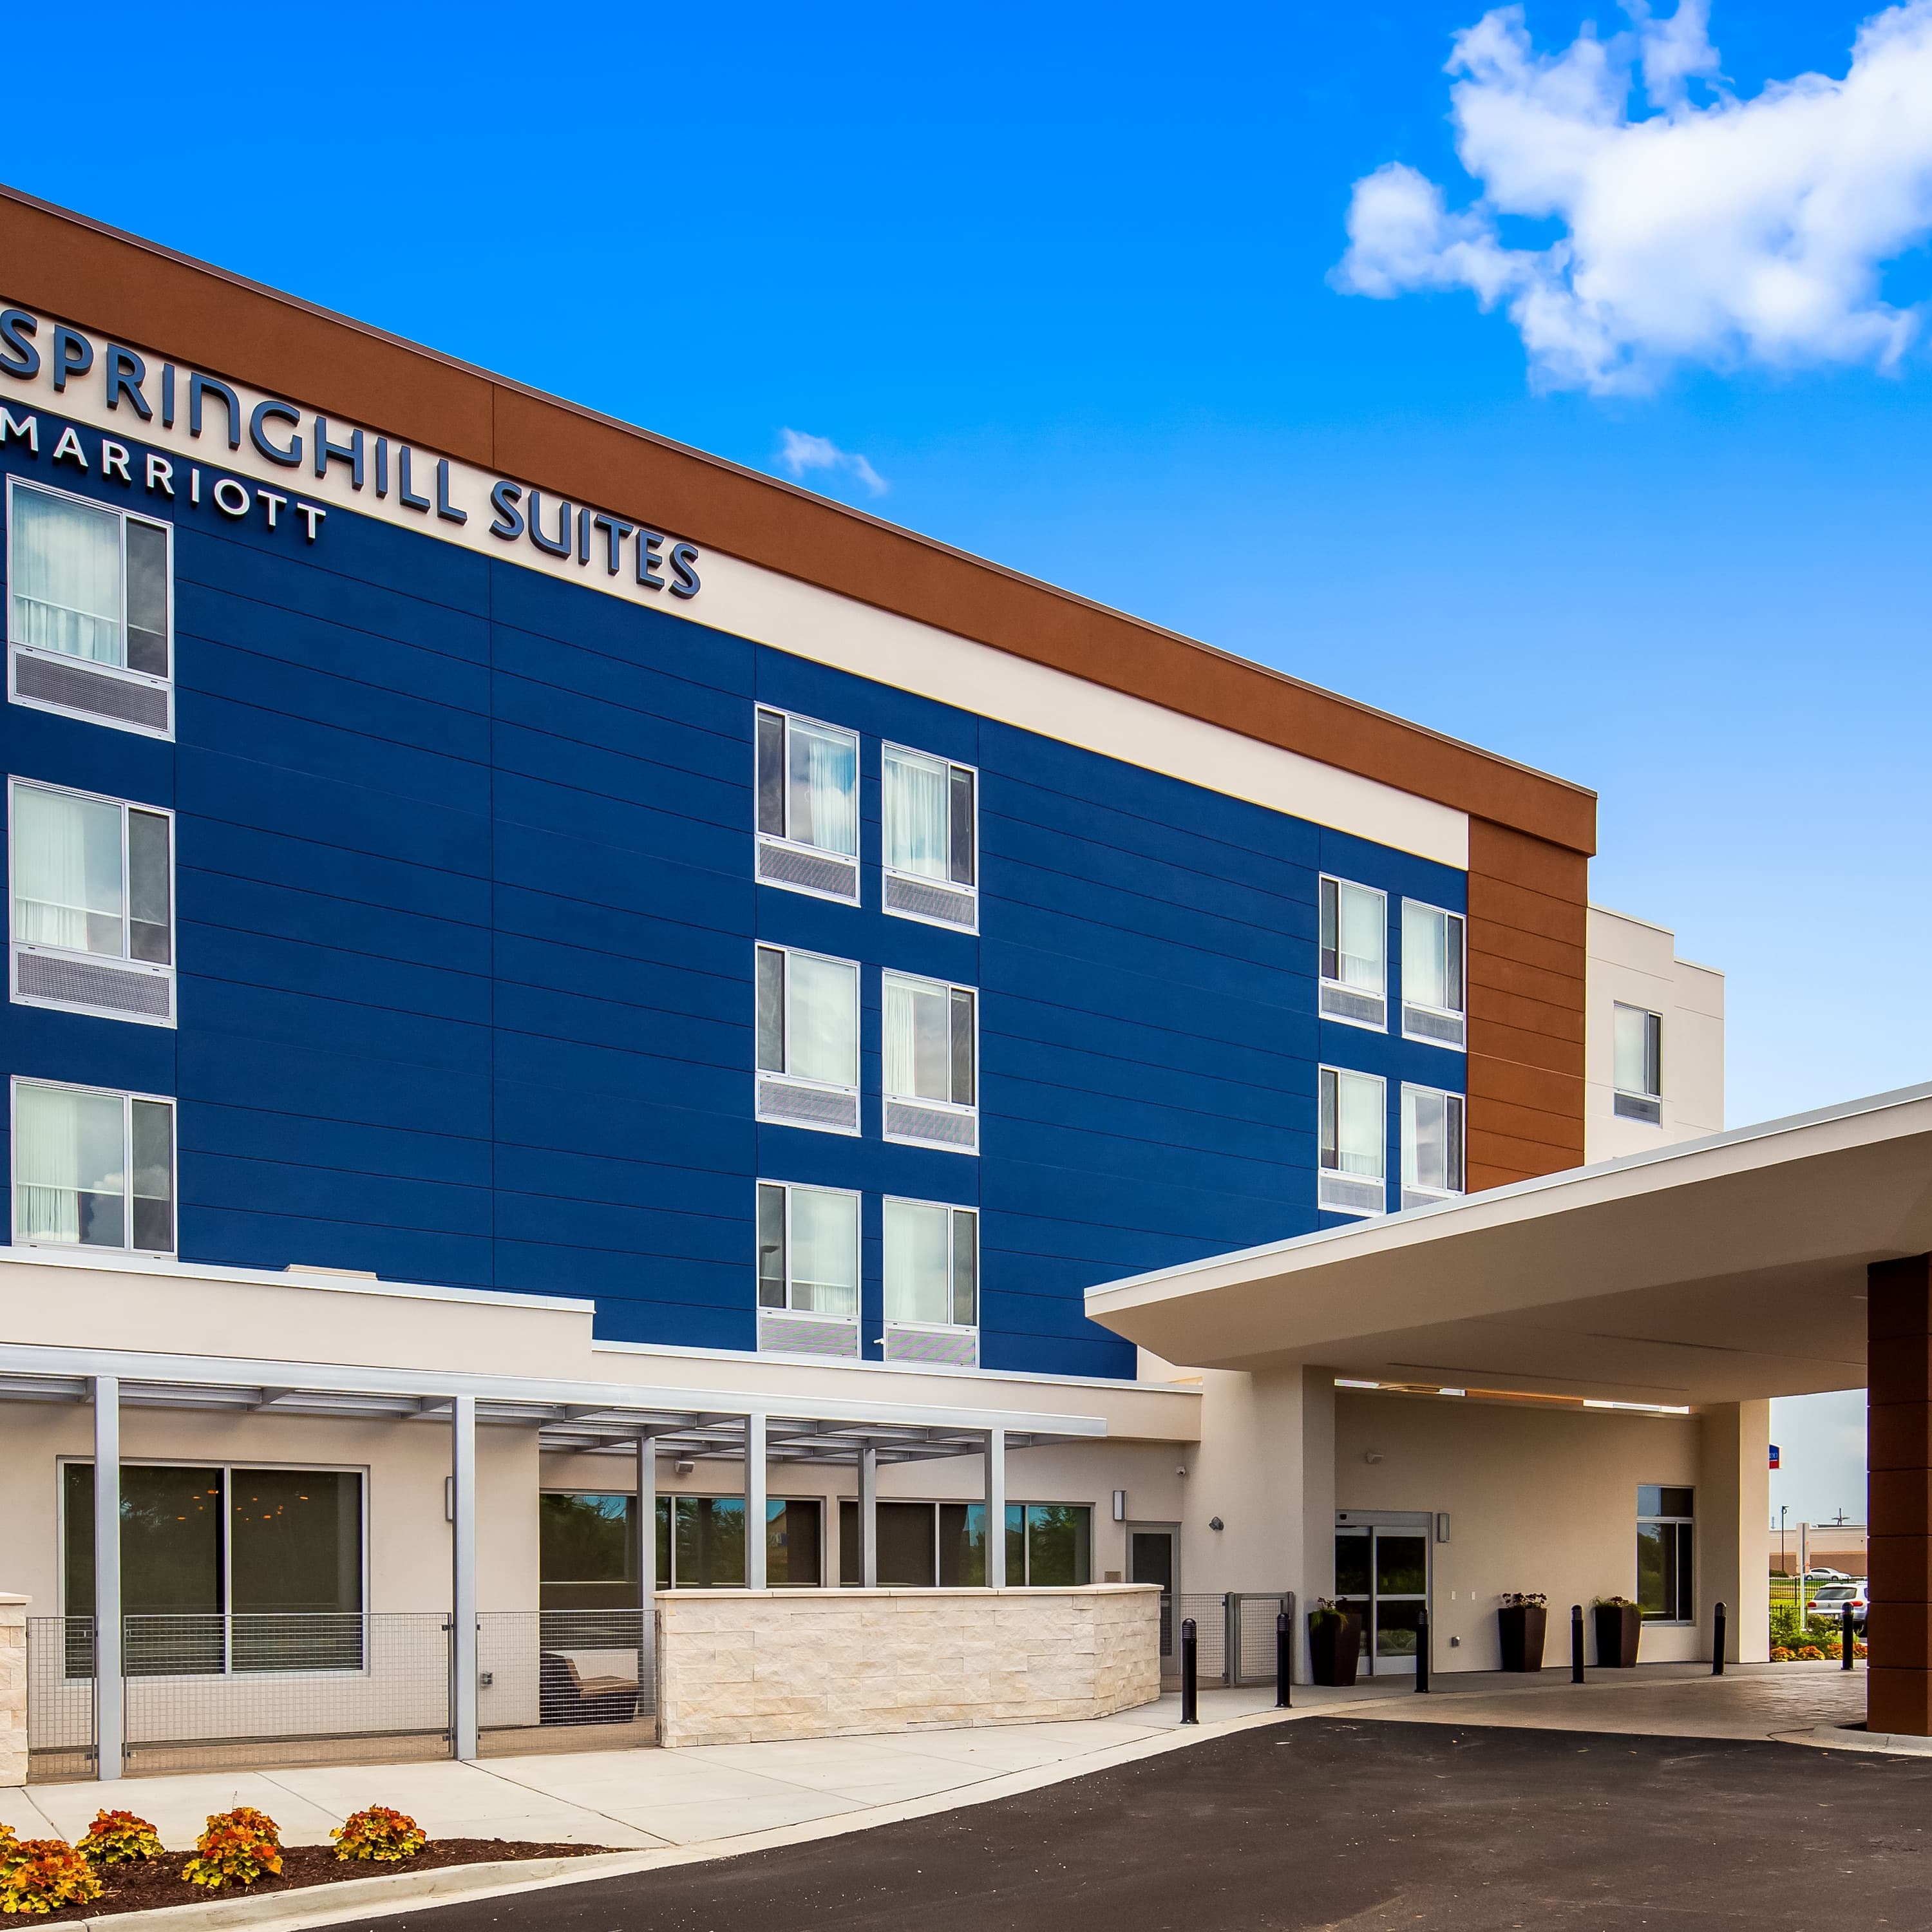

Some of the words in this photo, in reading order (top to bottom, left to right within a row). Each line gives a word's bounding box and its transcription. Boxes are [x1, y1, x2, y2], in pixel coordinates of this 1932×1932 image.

[0, 308, 468, 525] SPRINGHILL
[489, 480, 701, 600] SUITES
[0, 407, 327, 540] MARRIOTT
